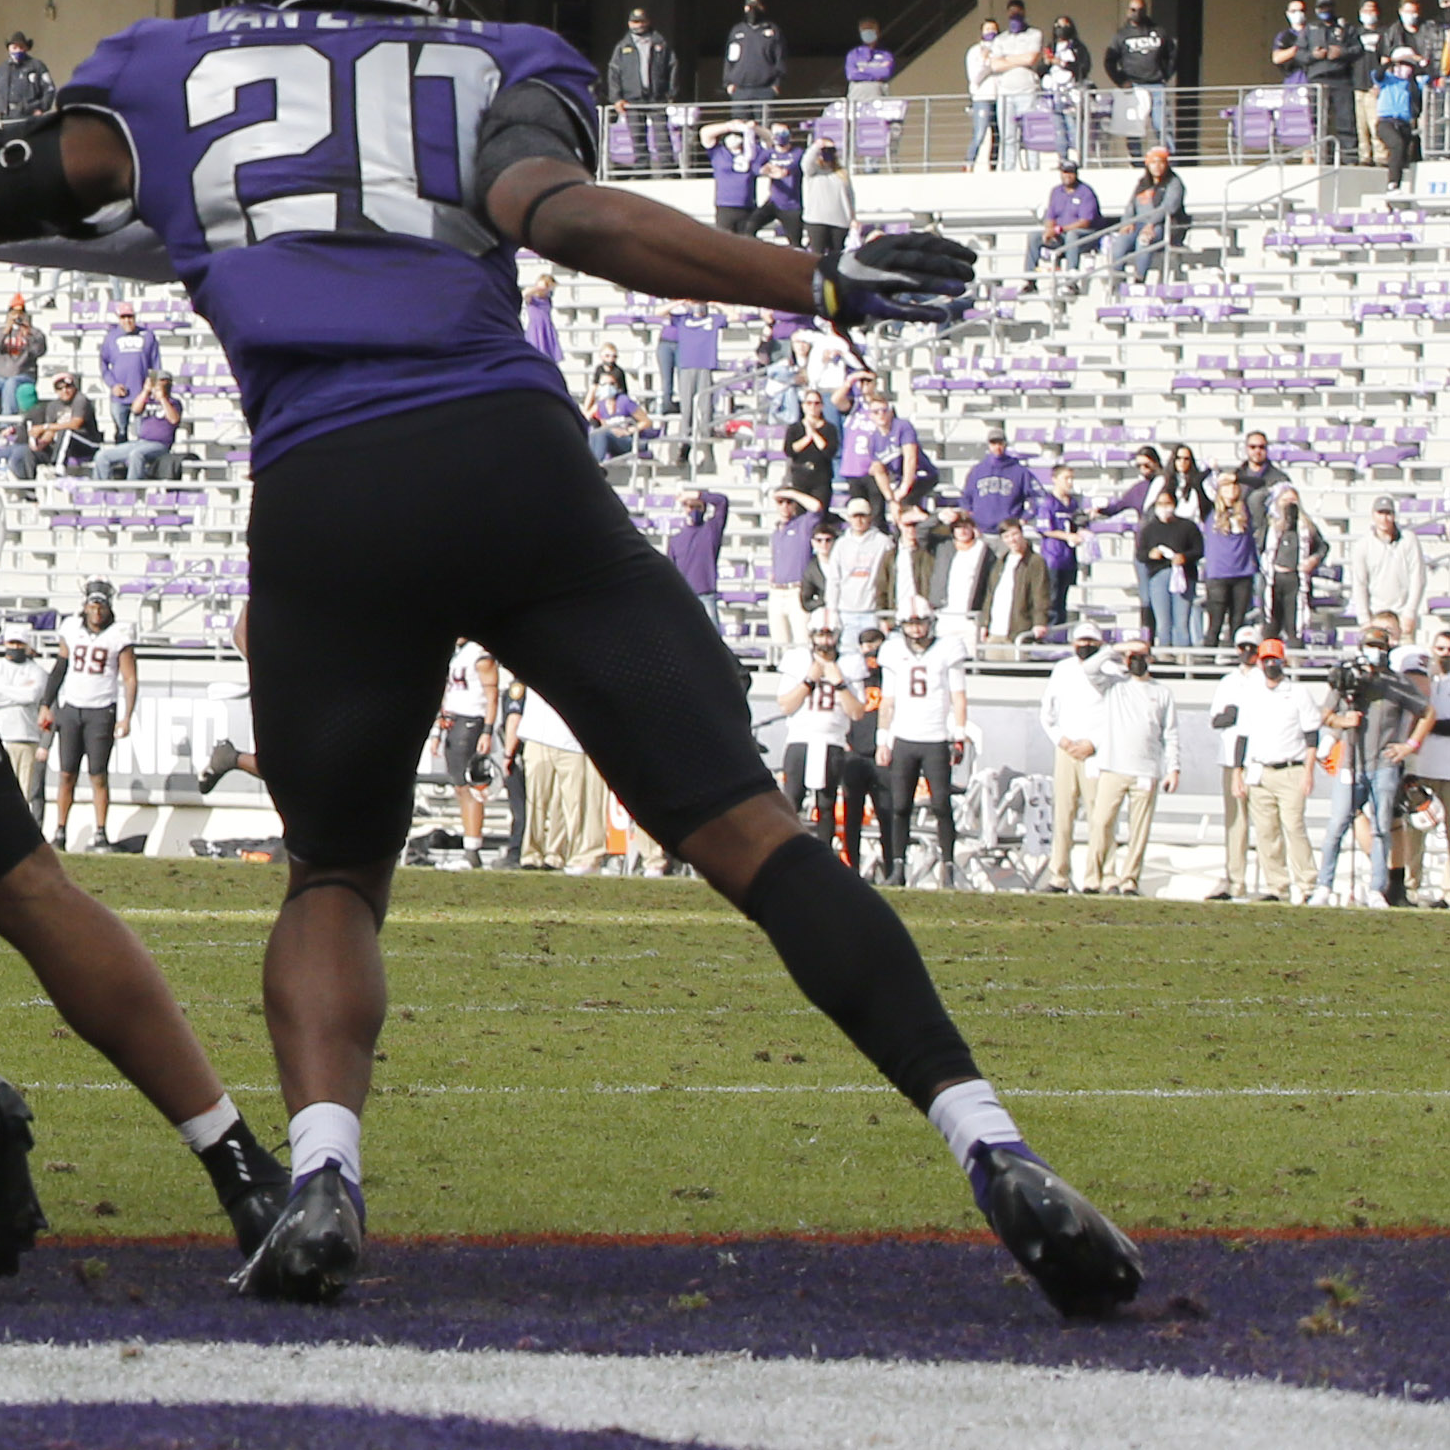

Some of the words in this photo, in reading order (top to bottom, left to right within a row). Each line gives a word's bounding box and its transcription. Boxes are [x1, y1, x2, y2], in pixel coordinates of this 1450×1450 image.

[186, 41, 502, 258] 20
[73, 644, 109, 675] 89
[909, 666, 928, 698] 6
